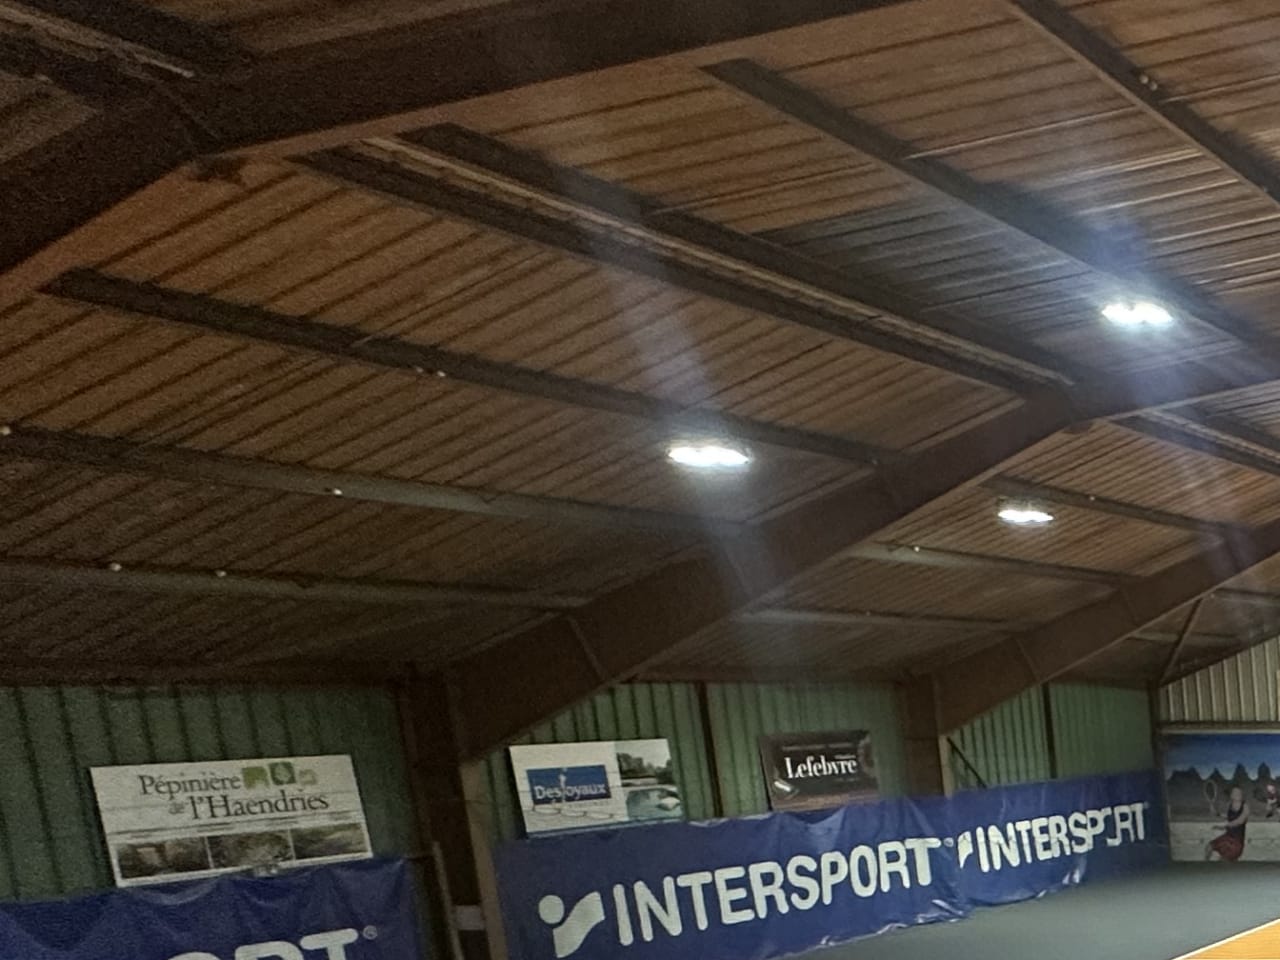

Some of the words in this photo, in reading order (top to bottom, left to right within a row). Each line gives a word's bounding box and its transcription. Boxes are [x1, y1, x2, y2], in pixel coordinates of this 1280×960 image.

[784, 755, 857, 778] Lefebvre
[138, 772, 241, 799] Pépinière
[613, 837, 940, 946] INTERSPORT
